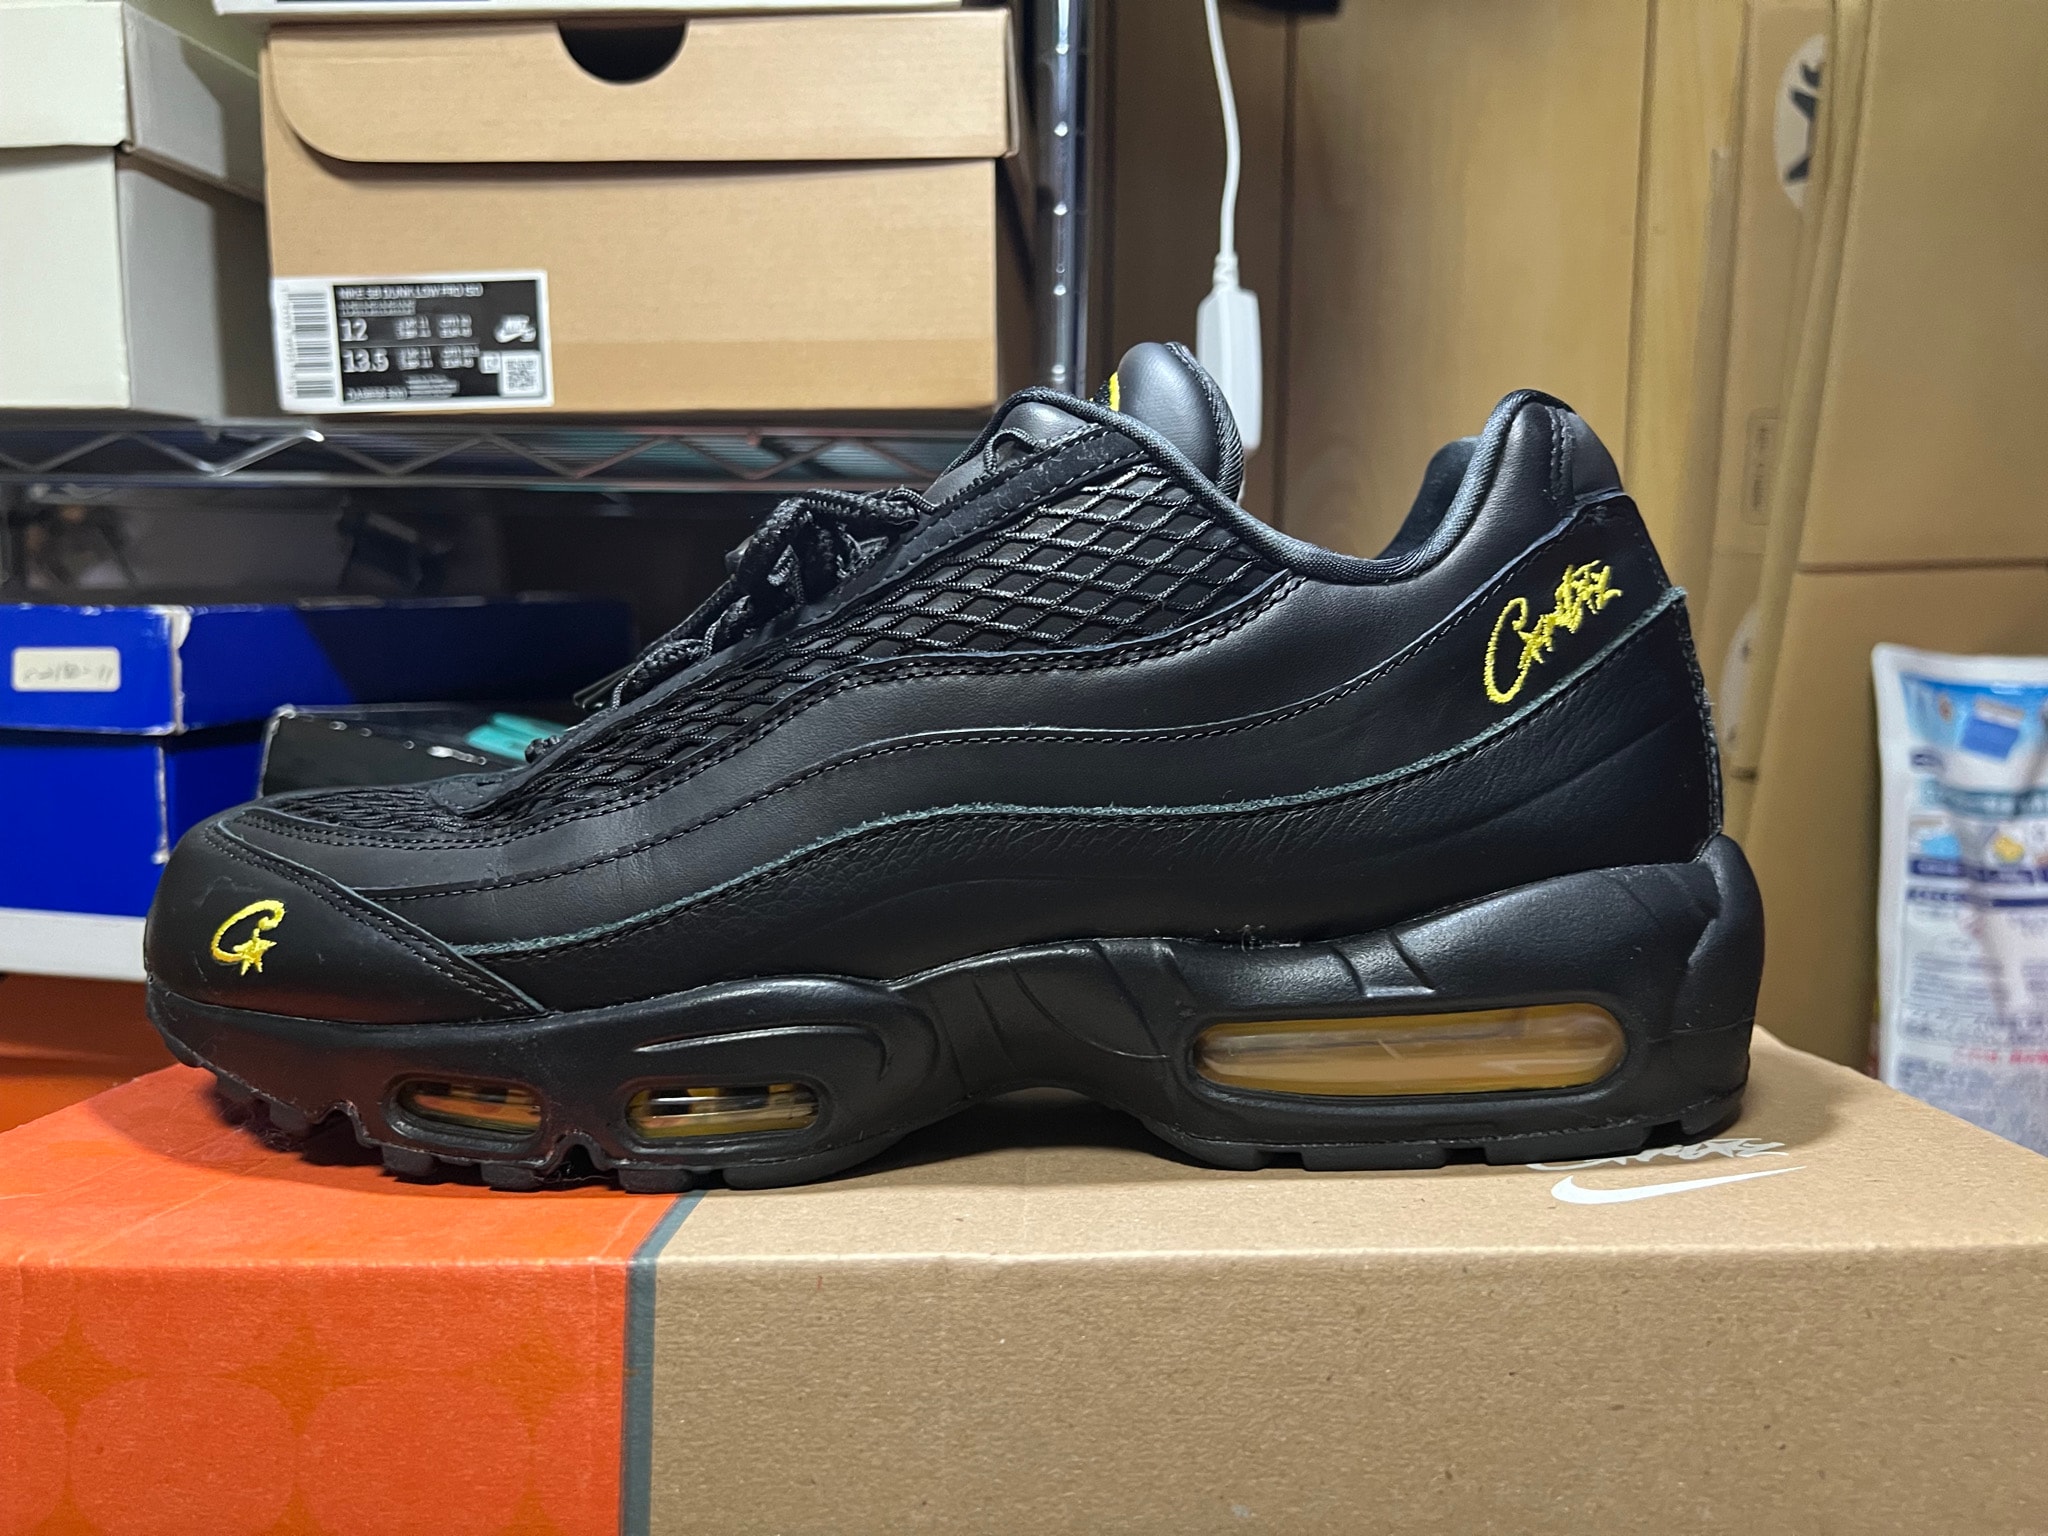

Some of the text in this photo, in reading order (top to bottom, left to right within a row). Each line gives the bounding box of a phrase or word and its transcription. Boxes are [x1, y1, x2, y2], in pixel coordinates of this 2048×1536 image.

[383, 285, 415, 299] DUNK
[416, 284, 440, 298] LOW
[339, 317, 369, 342] 12
[342, 347, 390, 373] 13.5
